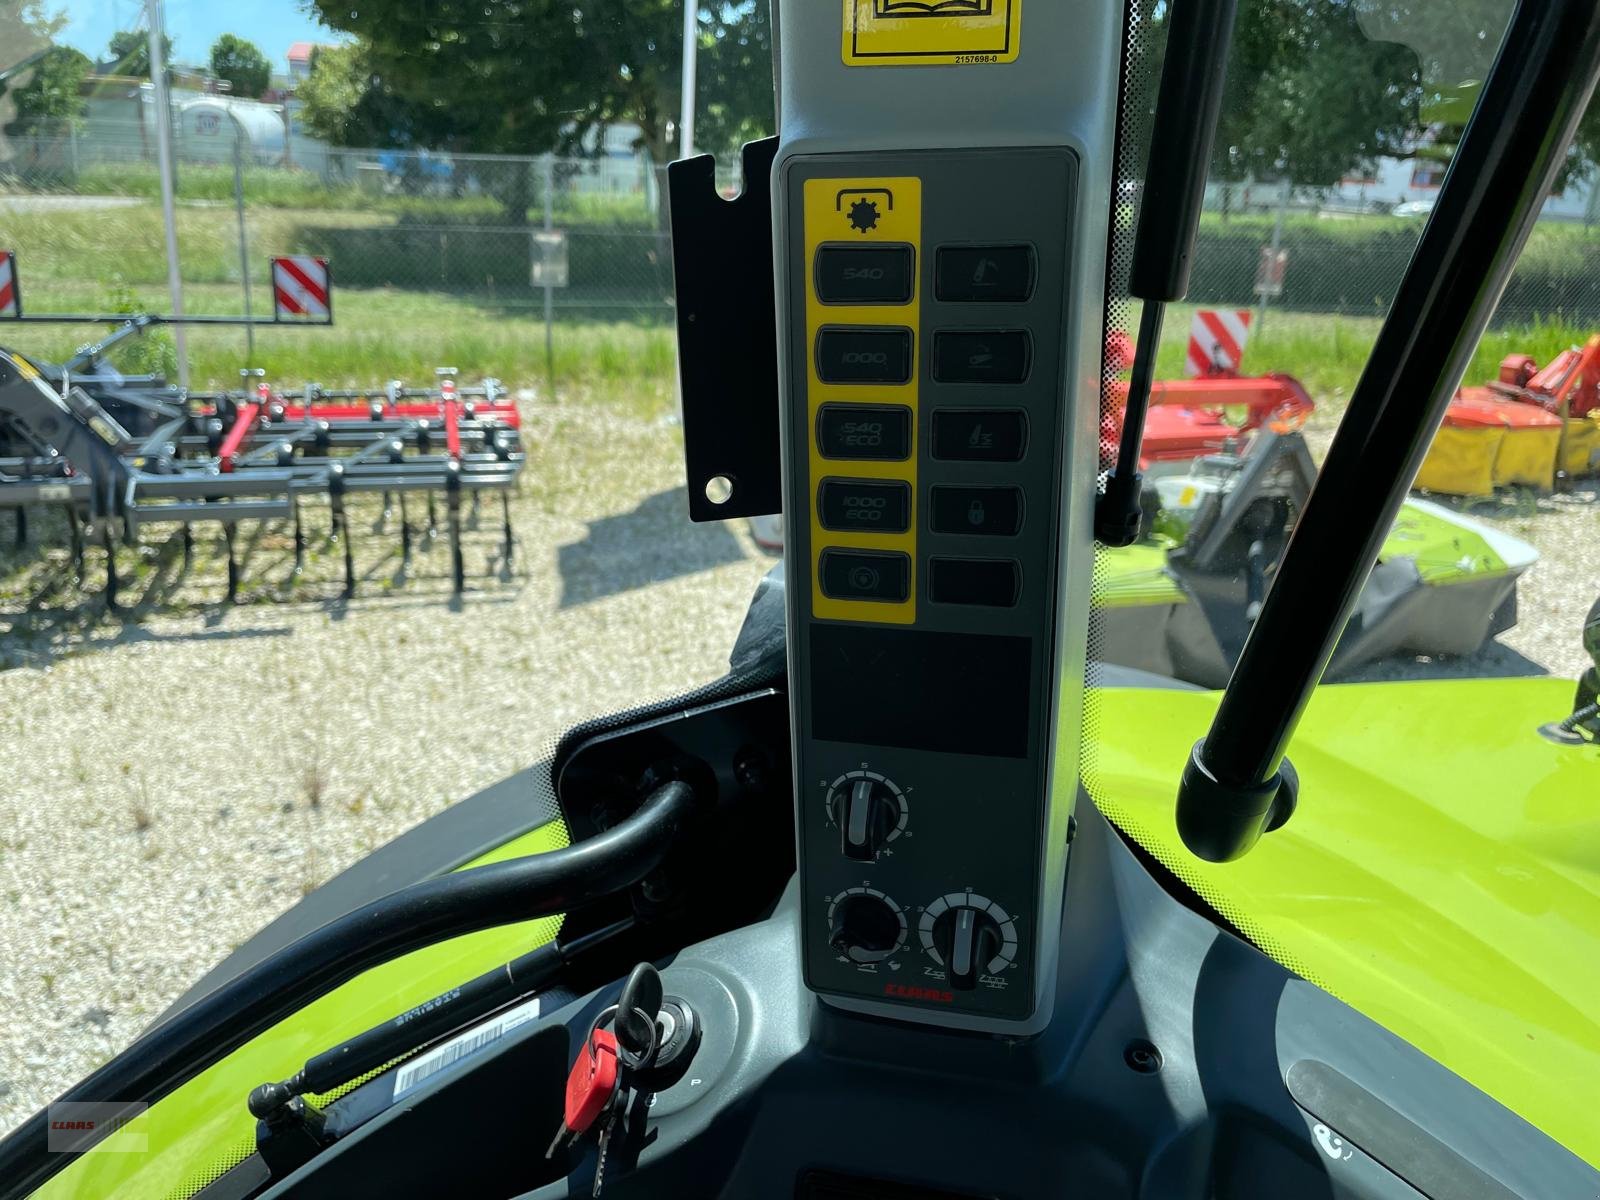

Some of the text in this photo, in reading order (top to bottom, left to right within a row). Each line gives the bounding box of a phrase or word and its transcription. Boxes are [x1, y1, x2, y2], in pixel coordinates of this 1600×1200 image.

[955, 55, 998, 64] 2157698-0
[842, 267, 884, 280] 540
[841, 352, 887, 365] 1000
[842, 422, 883, 434] 540
[845, 434, 881, 447] ECO
[842, 495, 887, 508] 1000
[845, 509, 882, 521] ECO
[885, 983, 953, 1001] CLAAS
[691, 1078, 702, 1086] P
